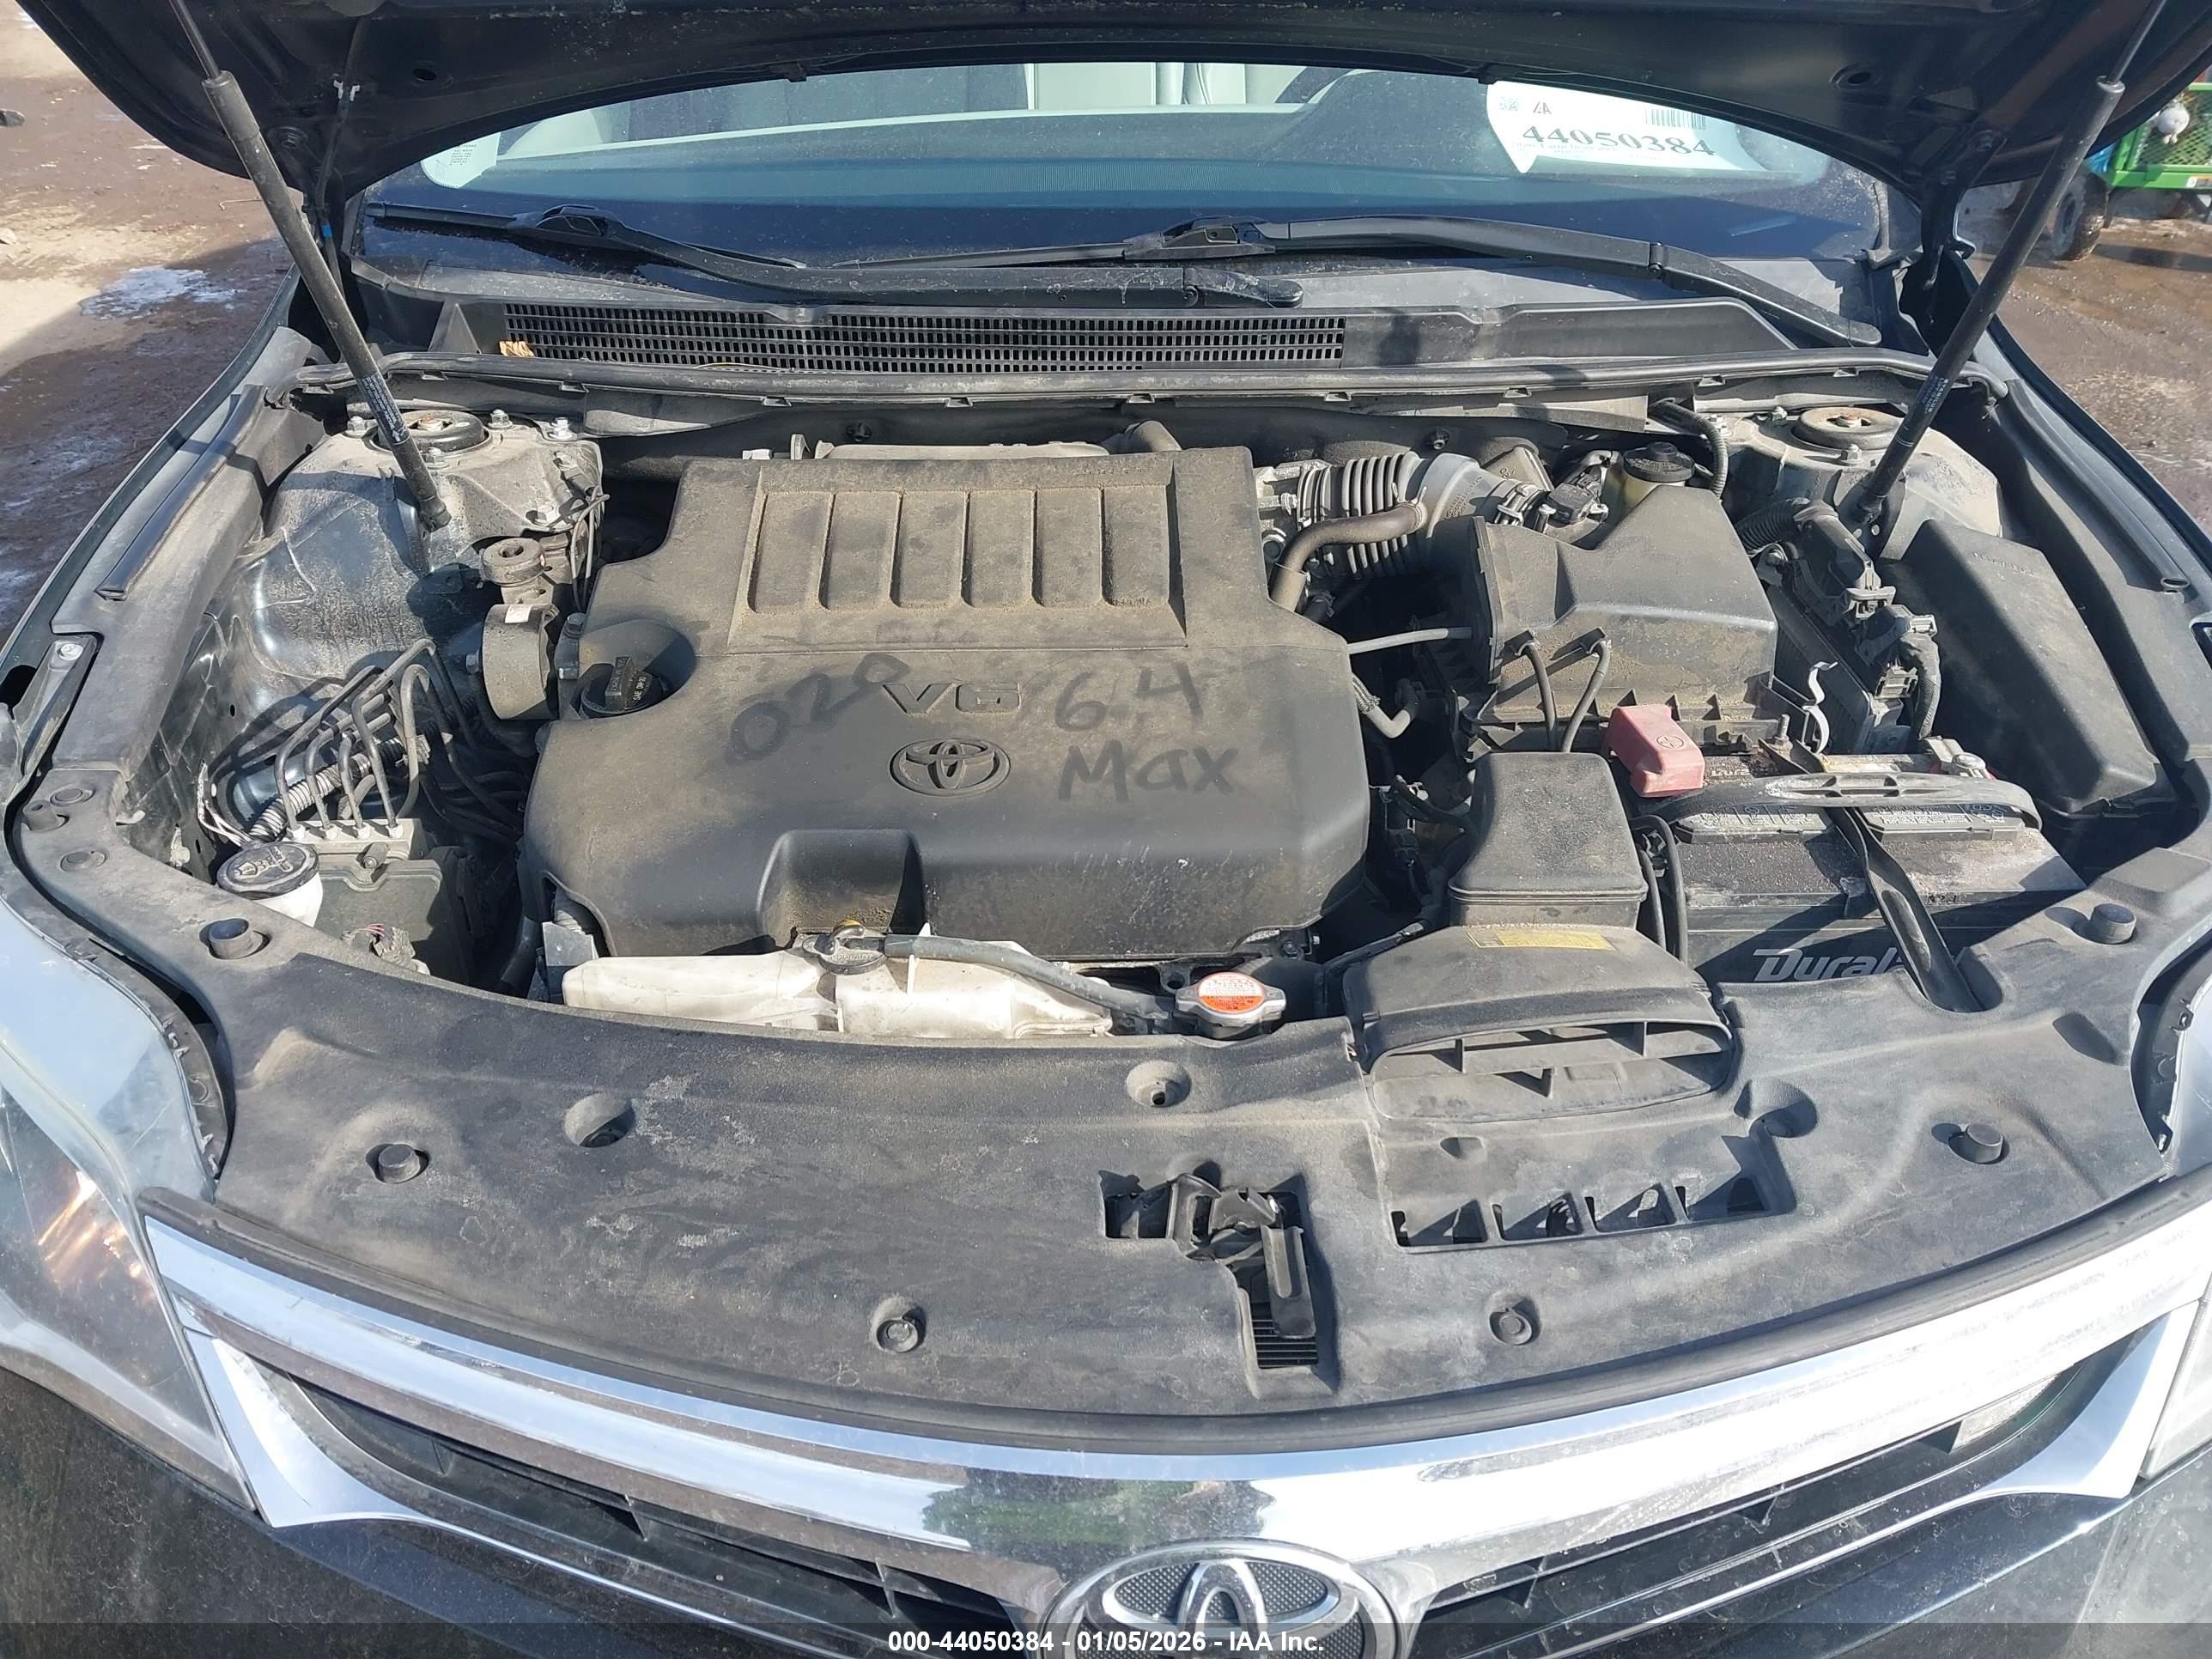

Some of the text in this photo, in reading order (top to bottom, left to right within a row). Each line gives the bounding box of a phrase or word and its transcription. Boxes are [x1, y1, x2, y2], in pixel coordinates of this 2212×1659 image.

[1522, 125, 1715, 156] 44050384
[881, 682, 1022, 714] V6
[1057, 738, 1239, 803] Max
[1752, 947, 1905, 982] Dural
